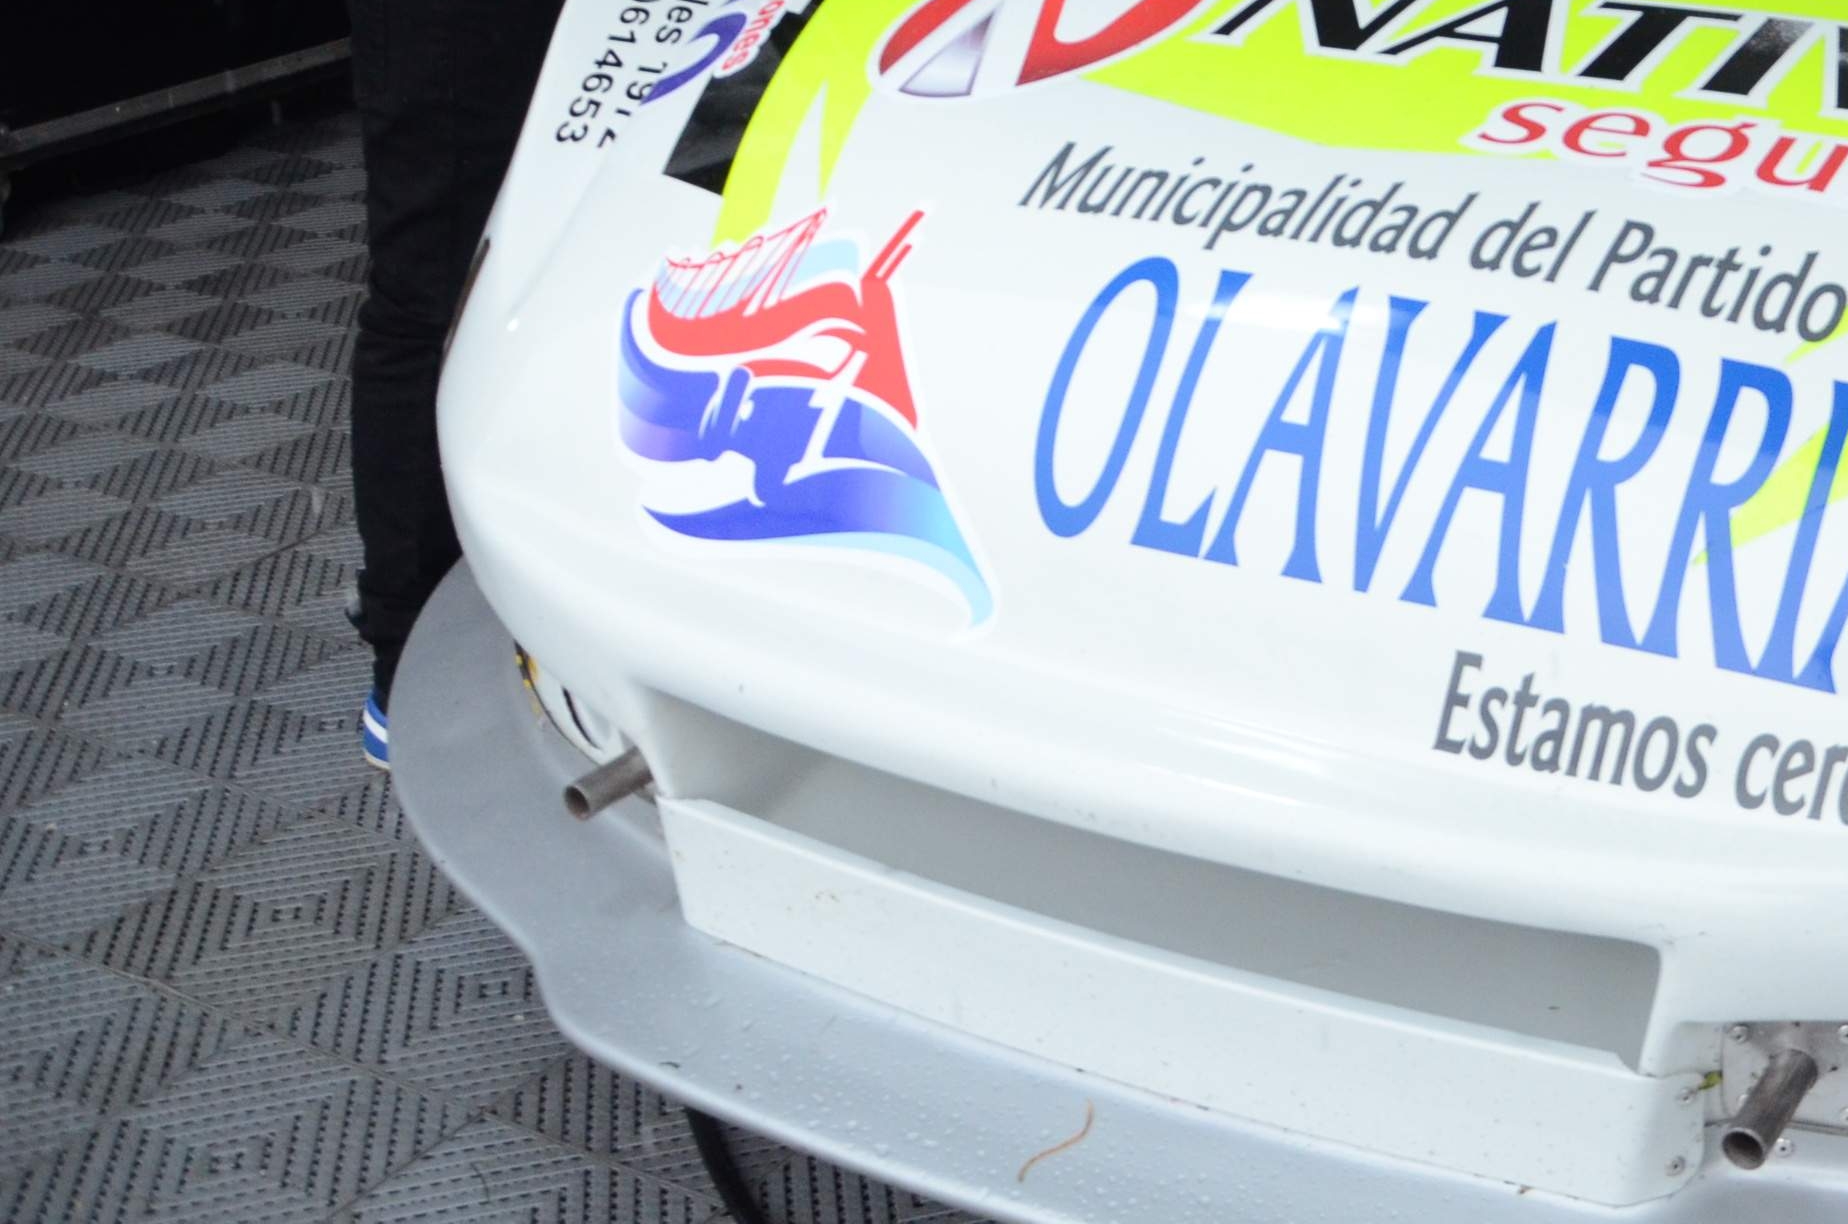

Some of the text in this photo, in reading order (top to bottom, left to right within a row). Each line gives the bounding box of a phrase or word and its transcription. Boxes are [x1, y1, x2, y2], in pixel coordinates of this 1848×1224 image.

[1018, 139, 1478, 264] Municipalidad
[1470, 204, 1587, 284] del
[1594, 223, 1848, 341] Partido
[1431, 649, 1723, 800] Estamos
